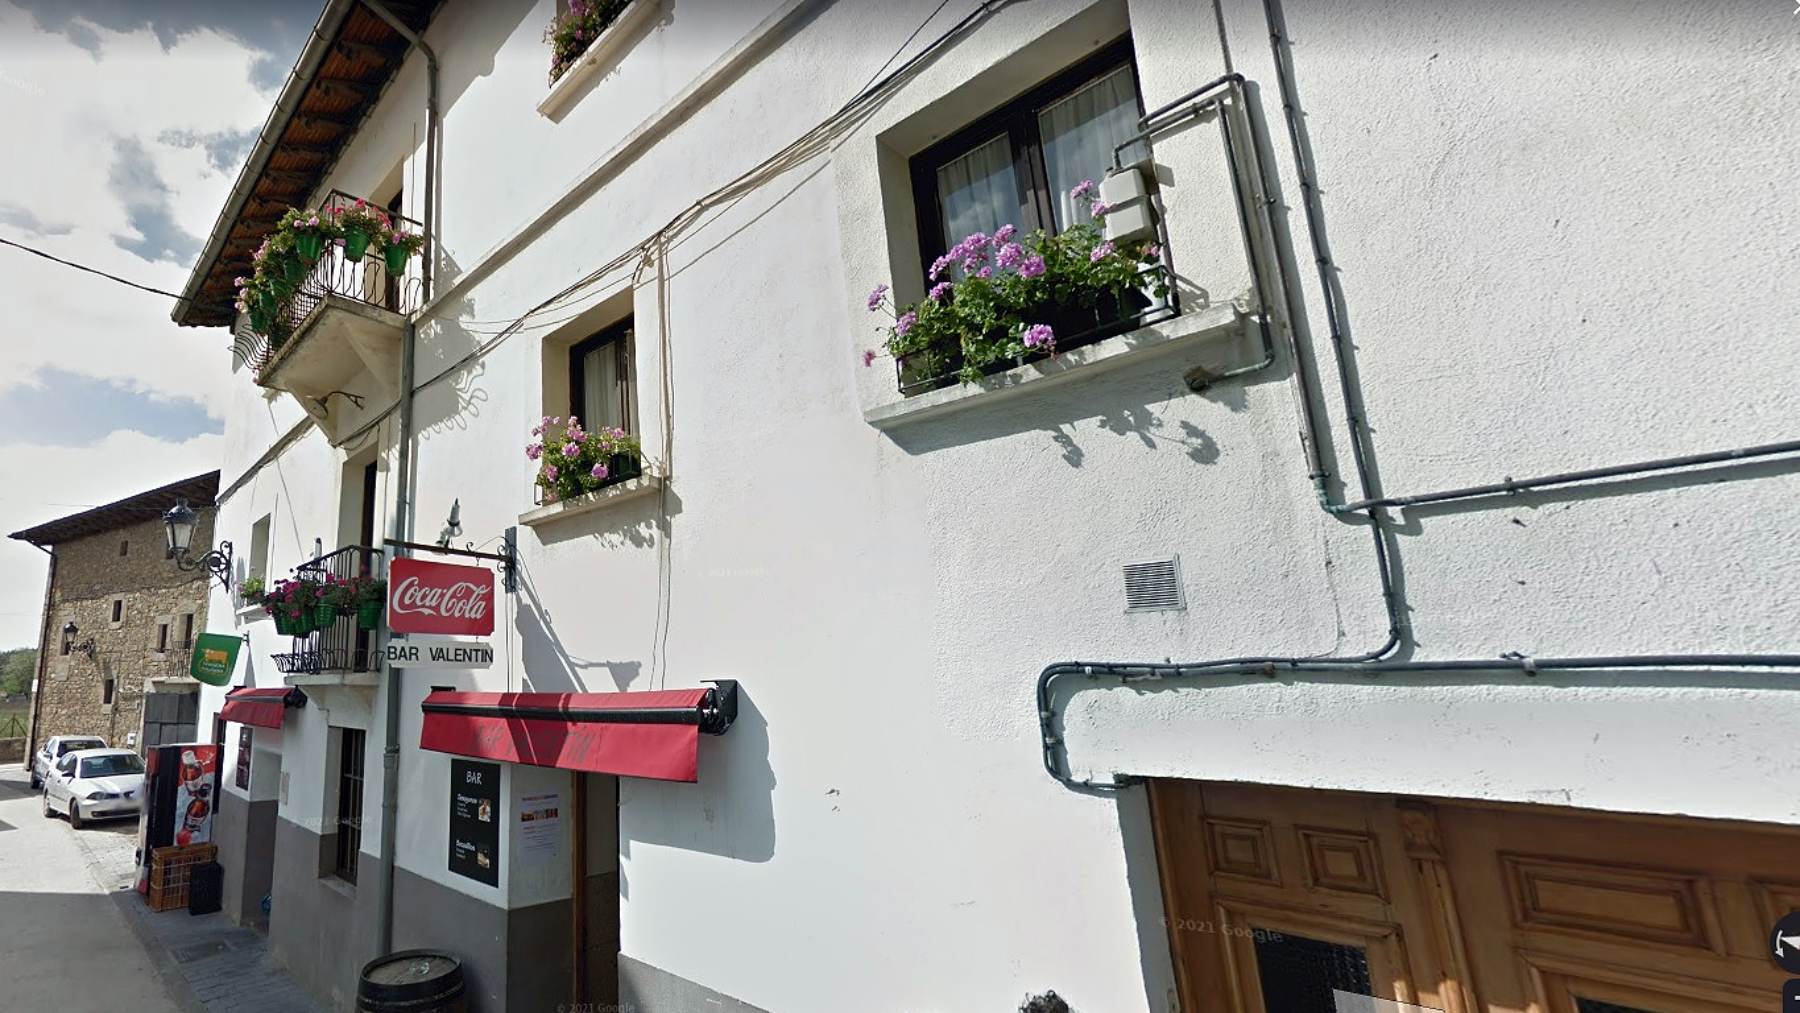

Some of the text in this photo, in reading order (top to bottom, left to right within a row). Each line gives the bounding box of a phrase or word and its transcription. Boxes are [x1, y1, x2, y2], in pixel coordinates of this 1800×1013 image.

[392, 576, 492, 619] Coca-Cola
[387, 645, 494, 663] BAR VALENTIN
[466, 770, 483, 785] BAR
